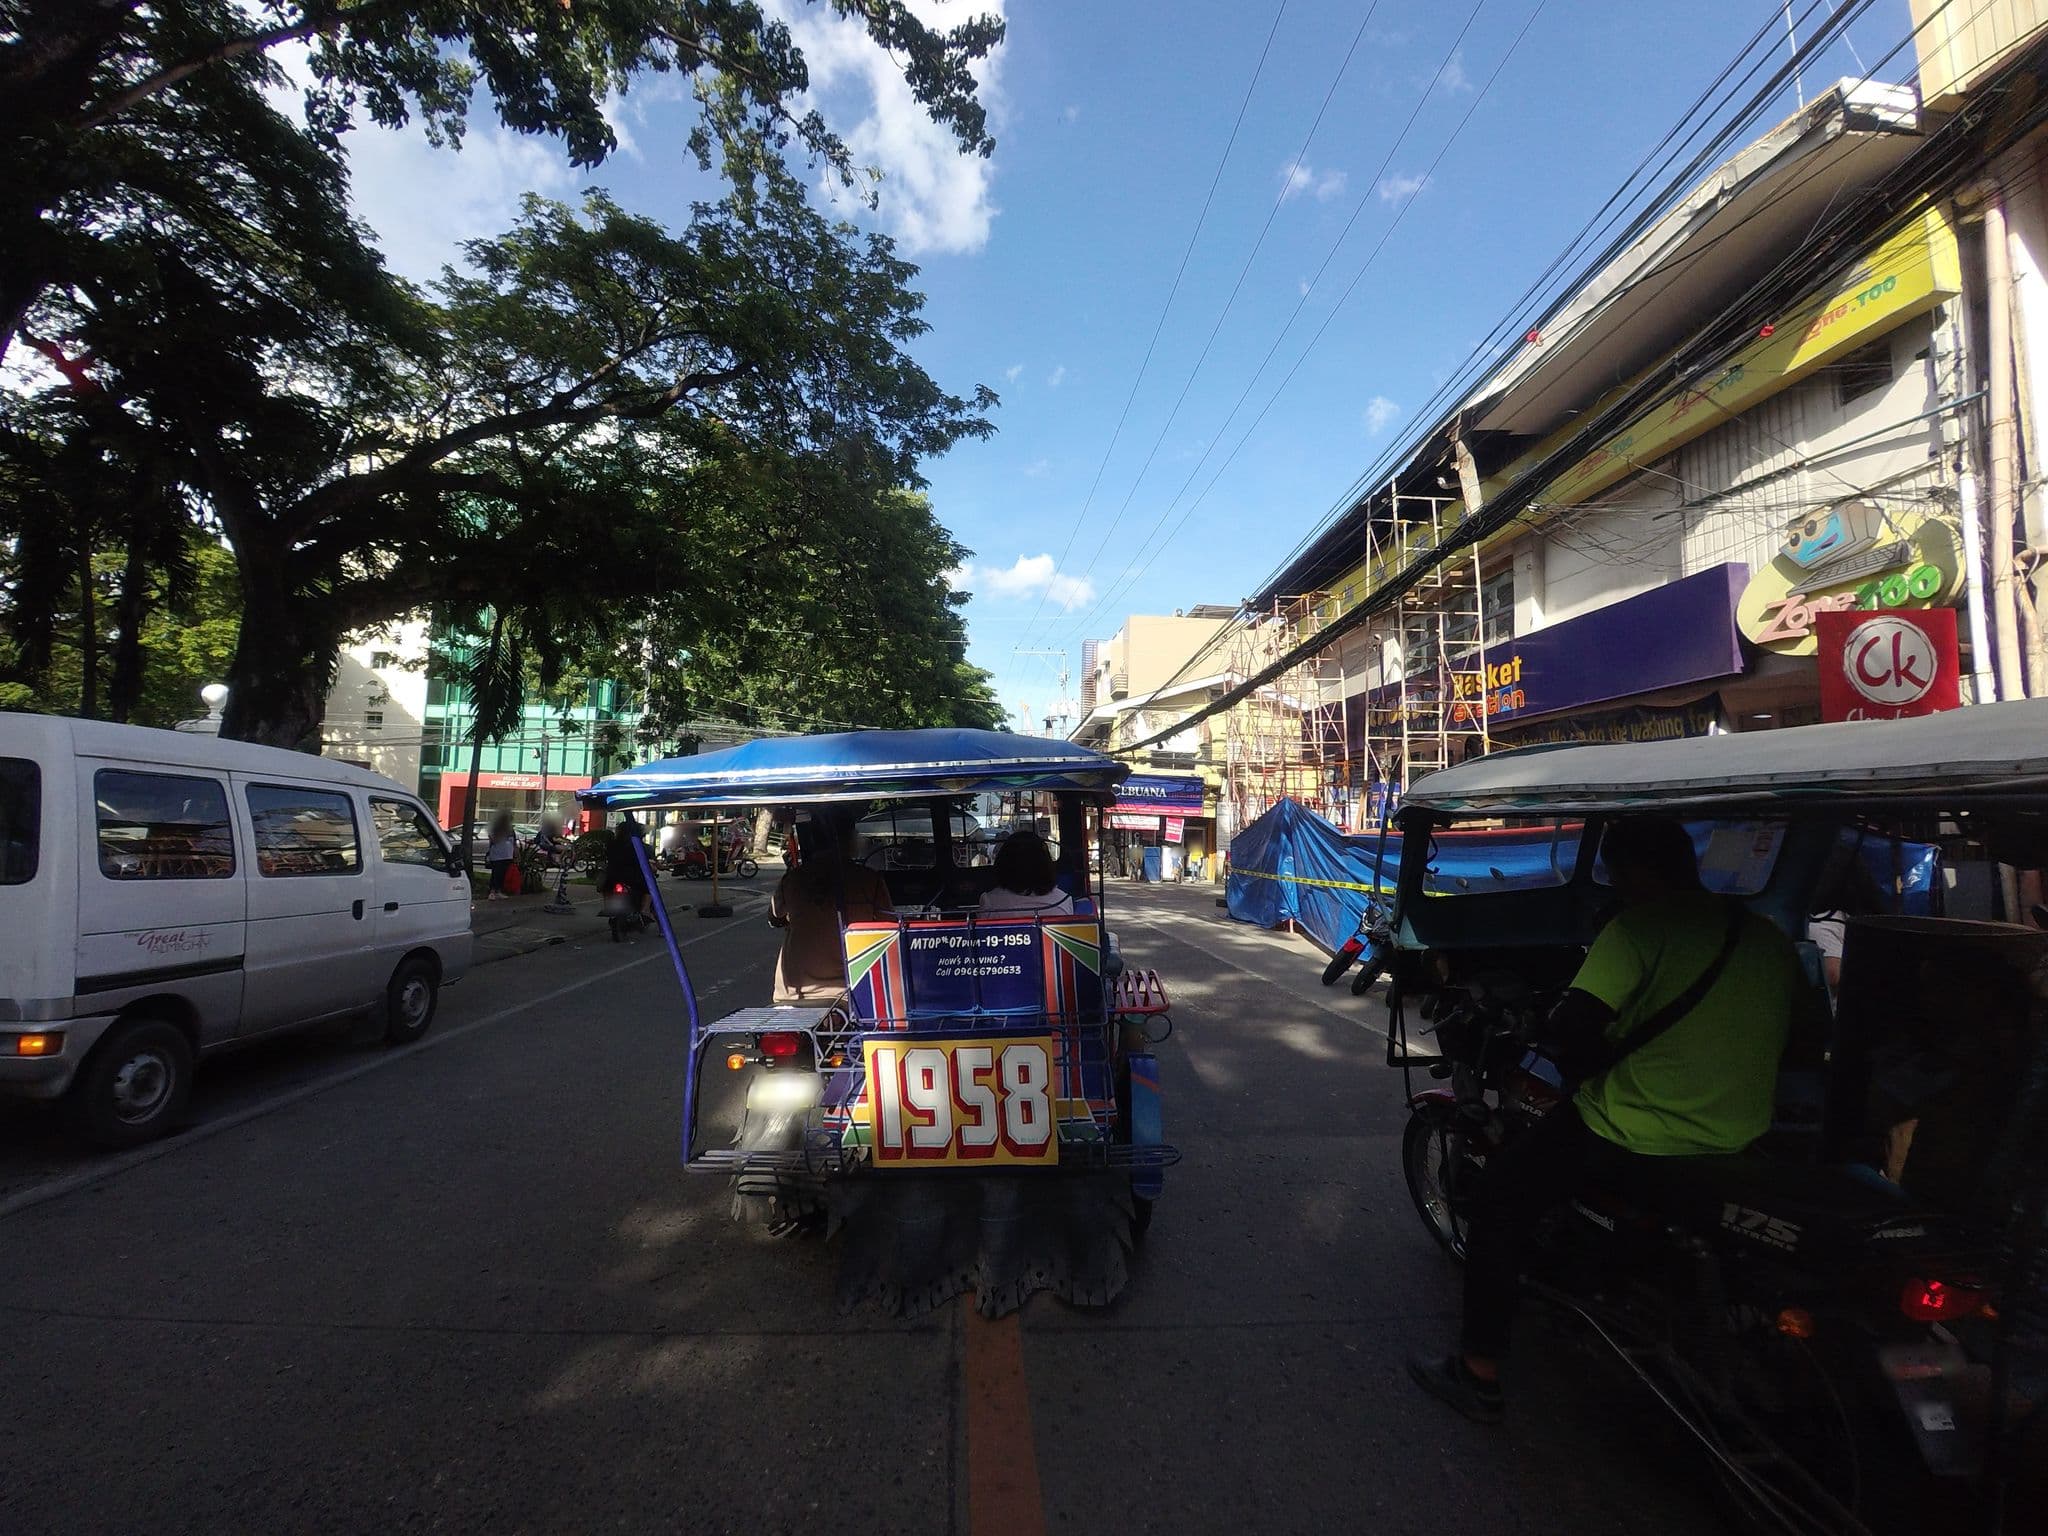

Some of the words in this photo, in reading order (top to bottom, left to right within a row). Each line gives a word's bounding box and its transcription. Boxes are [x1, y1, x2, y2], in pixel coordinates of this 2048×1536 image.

[1856, 630, 1928, 688] Ck
[1631, 714, 1686, 740] washing
[1111, 783, 1167, 798] CEBUANA
[137, 931, 186, 950] Great
[871, 1044, 1052, 1160] 1958
[1722, 1202, 1800, 1243] 175
